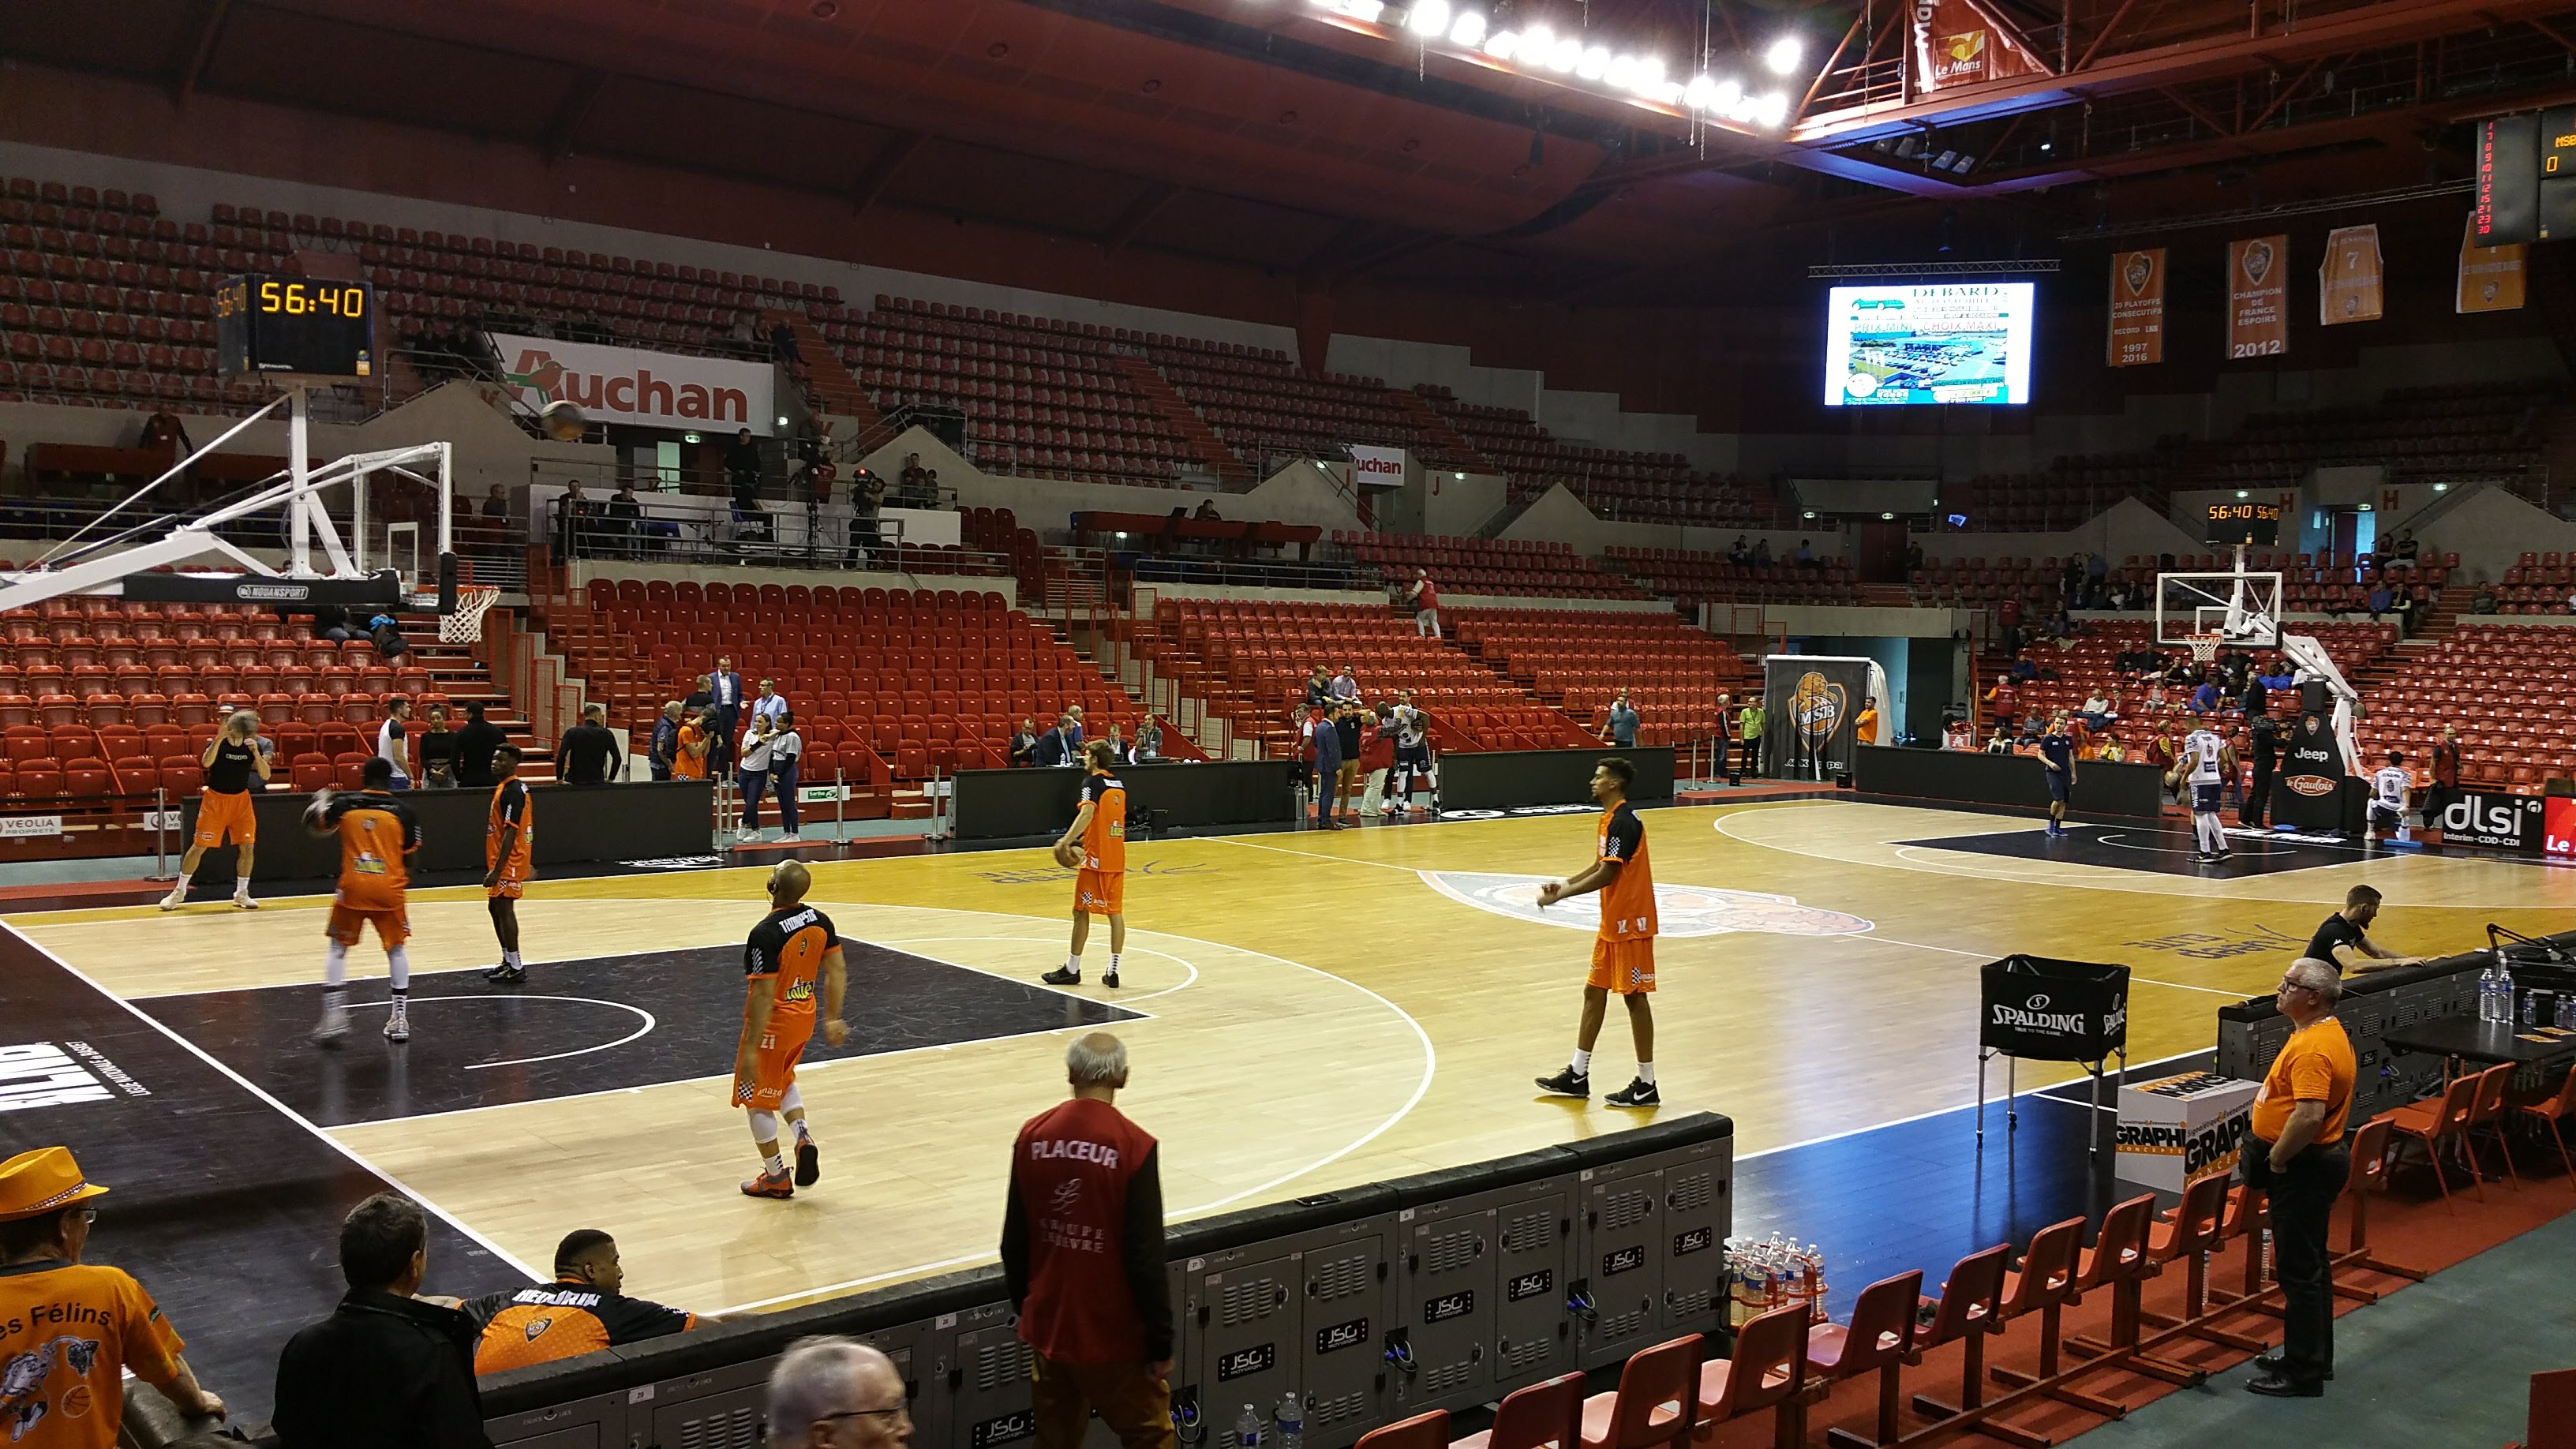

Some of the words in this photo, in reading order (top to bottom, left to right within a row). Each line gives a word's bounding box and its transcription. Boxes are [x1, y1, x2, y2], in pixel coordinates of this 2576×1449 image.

[1935, 64, 1948, 77] Le
[1950, 60, 1981, 74] Mans
[2481, 163, 2492, 172] 10
[2481, 174, 2492, 182] 11
[2481, 194, 2491, 203] 15
[2477, 205, 2492, 214] 21
[2477, 215, 2492, 224] 23
[2477, 226, 2490, 234] 30
[261, 282, 363, 317] 56:40
[2233, 286, 2282, 300] CHAMPION
[2114, 301, 2123, 309] 20
[2124, 298, 2162, 308] PLAYOFFS
[2113, 308, 2162, 319] CONSECUTIFS
[2239, 306, 2275, 317] FRANCE
[2237, 315, 2277, 326] ESPOIRS
[2114, 327, 2140, 335] RECORD
[2122, 343, 2148, 353] 1997
[2234, 340, 2281, 358] 2012
[2121, 354, 2147, 362] 2016
[511, 349, 748, 423] Auchan
[1351, 458, 1402, 474] uchan
[2279, 492, 2294, 512] H
[2383, 489, 2398, 511] H
[2209, 505, 2252, 519] 56:40
[2257, 505, 2278, 521] 56:40
[2294, 747, 2329, 762] Jeep
[2293, 777, 2334, 792] Gaulois
[2444, 795, 2523, 836] dlsi
[6, 818, 55, 829] VEOLIA
[2546, 835, 2570, 852] Le
[778, 908, 818, 934] THOMPSON
[1992, 1003, 2086, 1035] SPALDING
[1031, 1140, 1119, 1170] PLACEUR
[2118, 1145, 2183, 1155] CONCEPTS
[30, 1302, 112, 1327] Félins
[526, 1323, 546, 1333] MSB
[1327, 1337, 1357, 1349] technologies
[1230, 1364, 1263, 1376] technologies
[987, 1430, 1025, 1443] technologies
